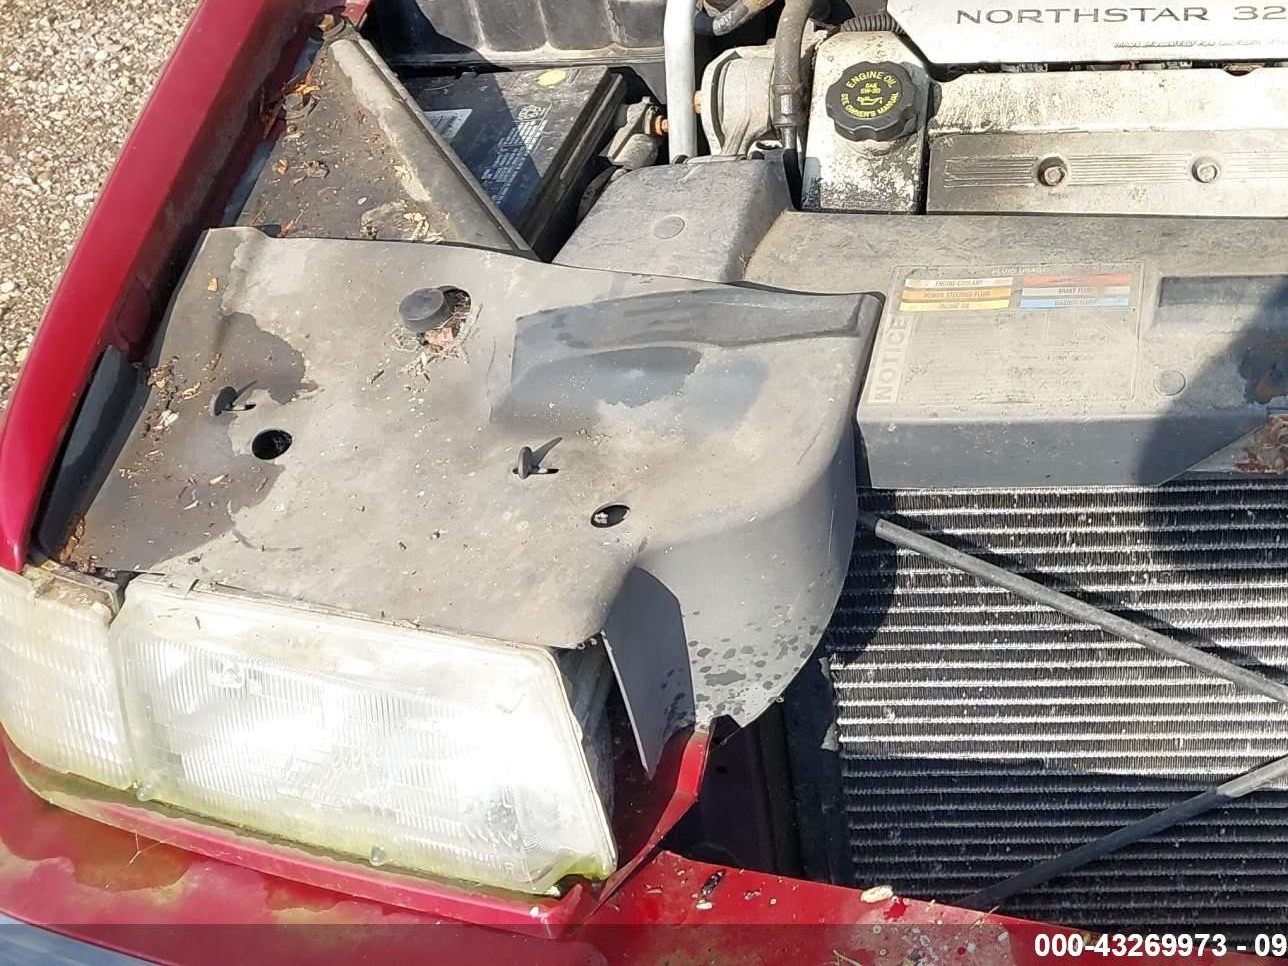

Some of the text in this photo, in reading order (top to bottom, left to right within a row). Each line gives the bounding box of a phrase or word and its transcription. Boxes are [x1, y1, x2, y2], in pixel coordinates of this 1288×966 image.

[955, 6, 1210, 25] NORTHSTAR
[1232, 4, 1288, 21] 32
[846, 71, 896, 88] ENGINE OIL
[841, 93, 849, 106] SEE
[877, 92, 899, 114] MANUAL
[874, 316, 907, 401] NOTICE
